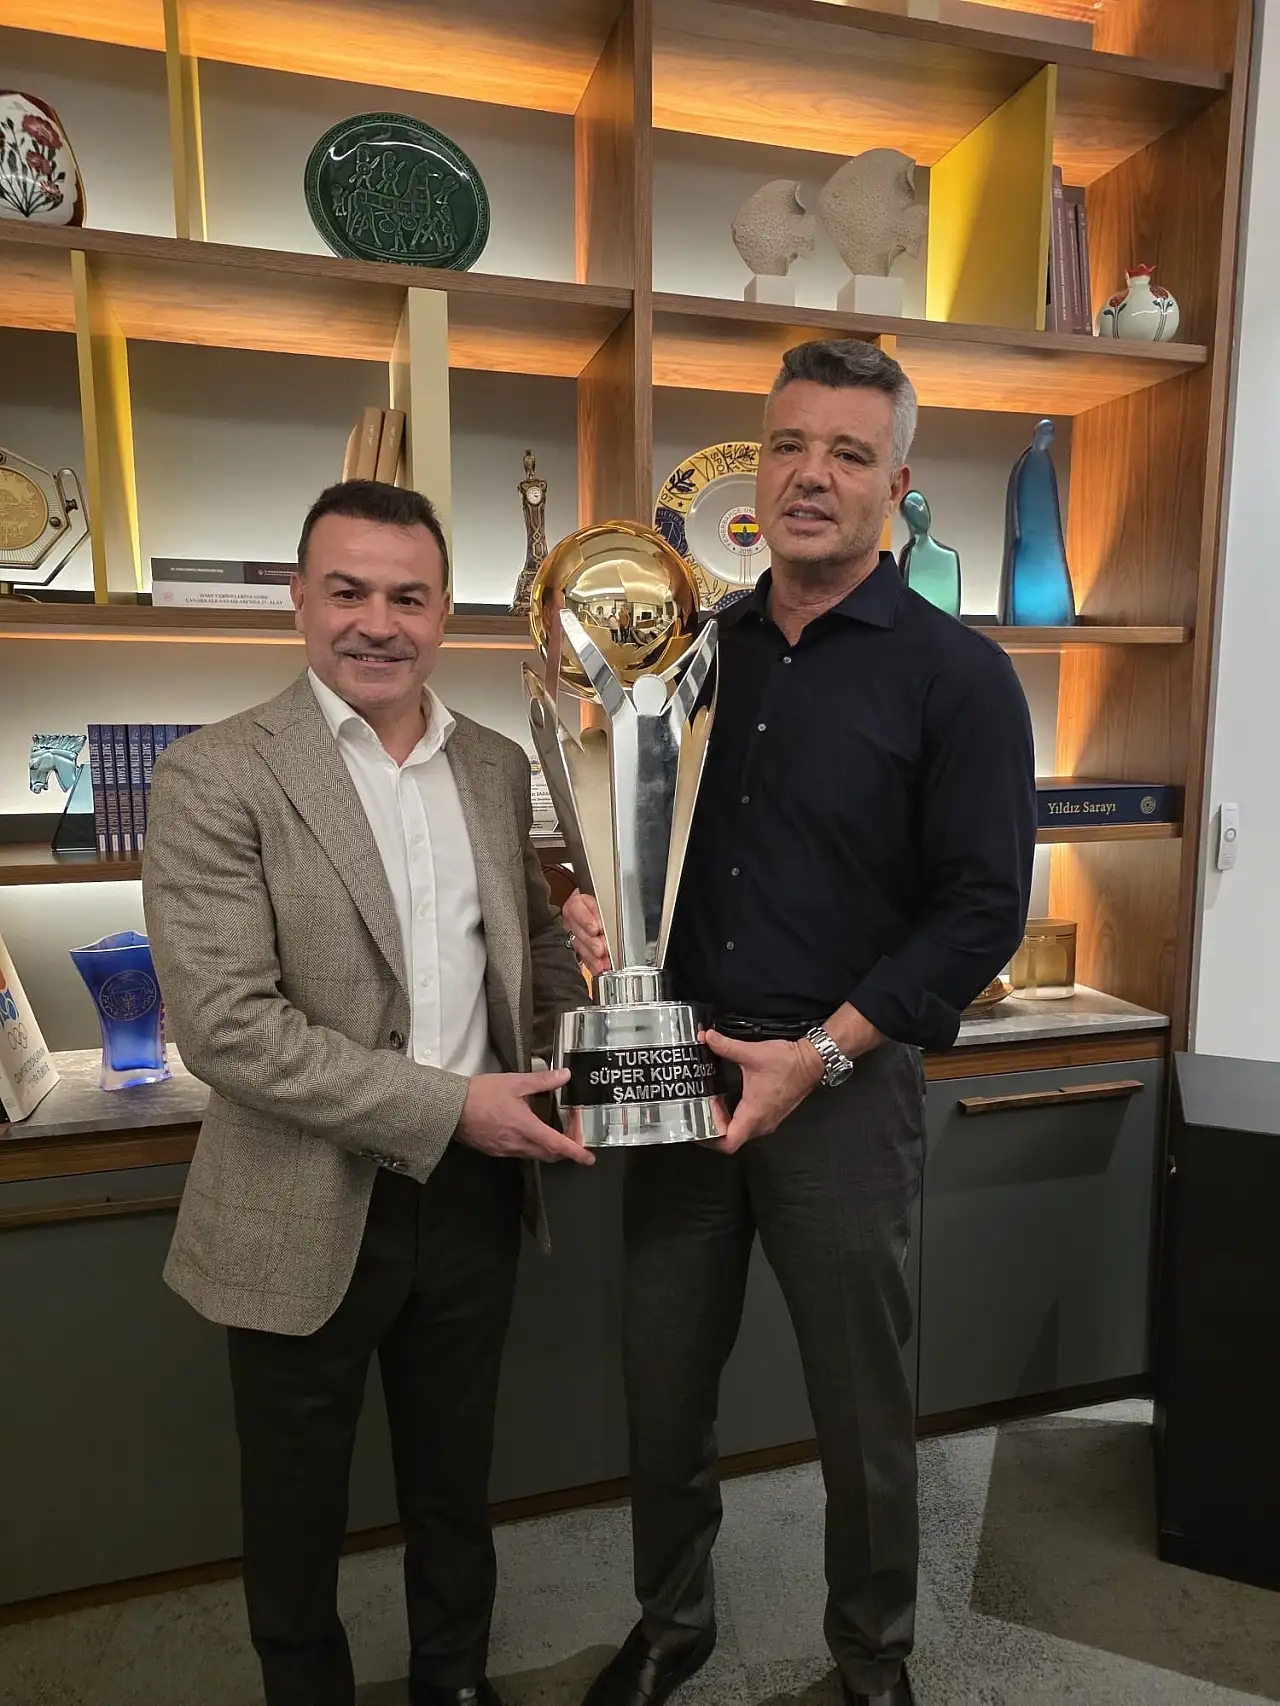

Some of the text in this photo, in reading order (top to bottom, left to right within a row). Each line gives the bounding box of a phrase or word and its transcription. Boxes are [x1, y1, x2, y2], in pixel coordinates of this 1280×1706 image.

[1047, 801, 1116, 816] Yıldız Sarayı
[615, 1047, 699, 1067] TURKCELL
[589, 1067, 645, 1085] SÜPER
[650, 1064, 692, 1082] KUPA
[612, 1081, 705, 1105] ŞAMPİYONU
